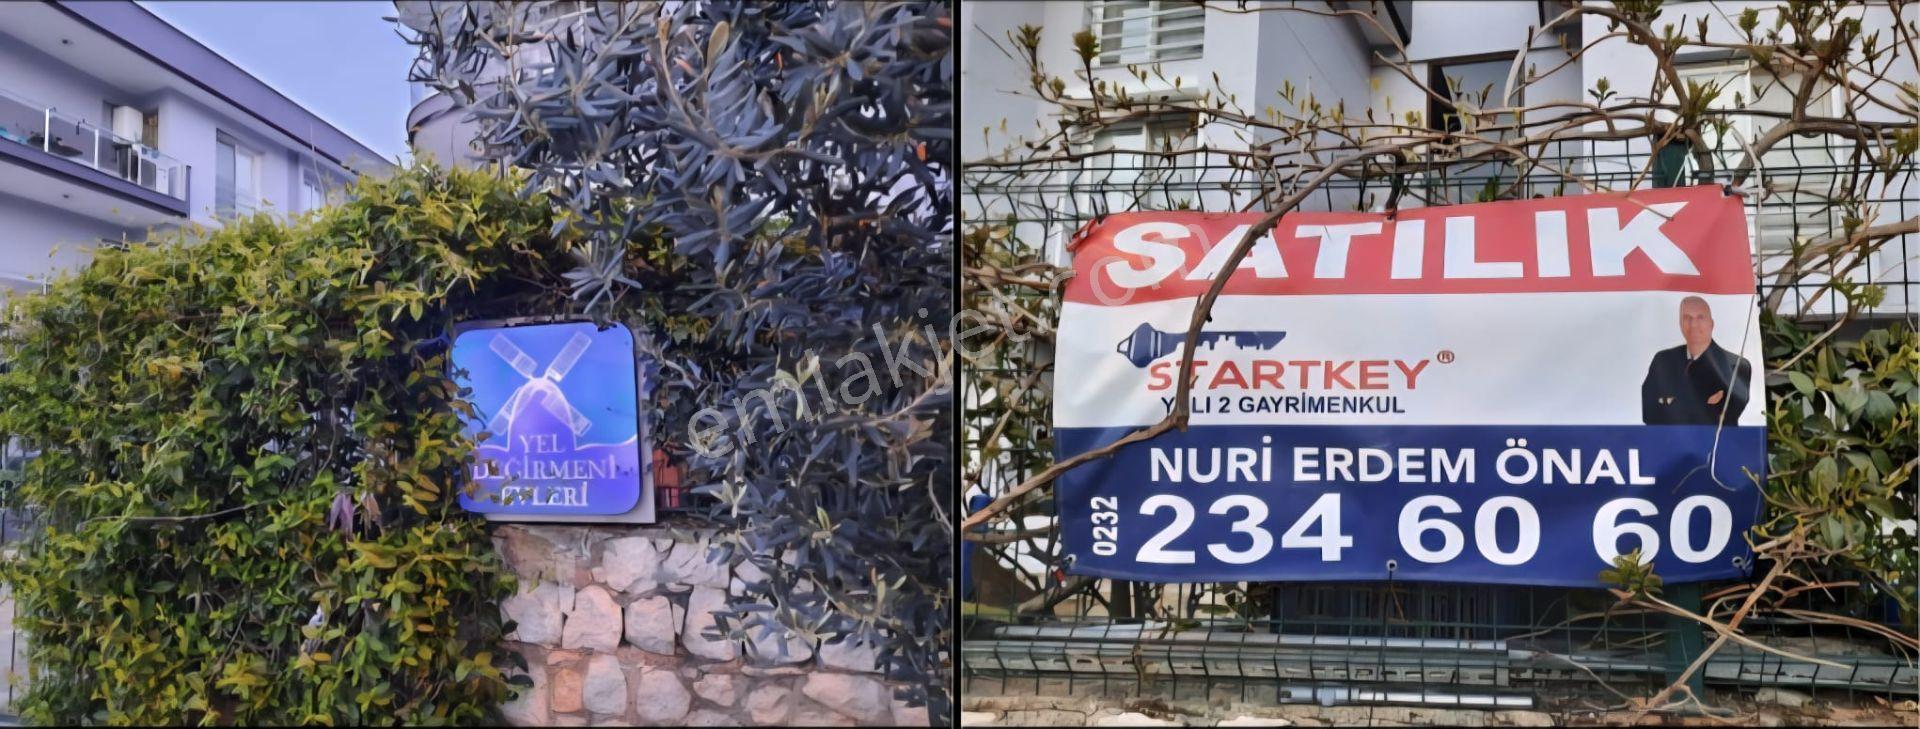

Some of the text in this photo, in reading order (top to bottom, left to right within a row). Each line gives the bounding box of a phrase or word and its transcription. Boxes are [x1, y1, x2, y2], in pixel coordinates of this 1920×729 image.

[1106, 201, 1700, 288] SATILIK
[1147, 360, 1430, 391] STARTKEY
[1161, 392, 1405, 413] YLI 2 GAYRİMENKUL
[519, 433, 566, 453] YEL
[1150, 435, 1656, 485] NURİ ERDEM ÖNAL
[1090, 496, 1118, 556] 0232
[1136, 492, 1733, 569] 234 60 60
